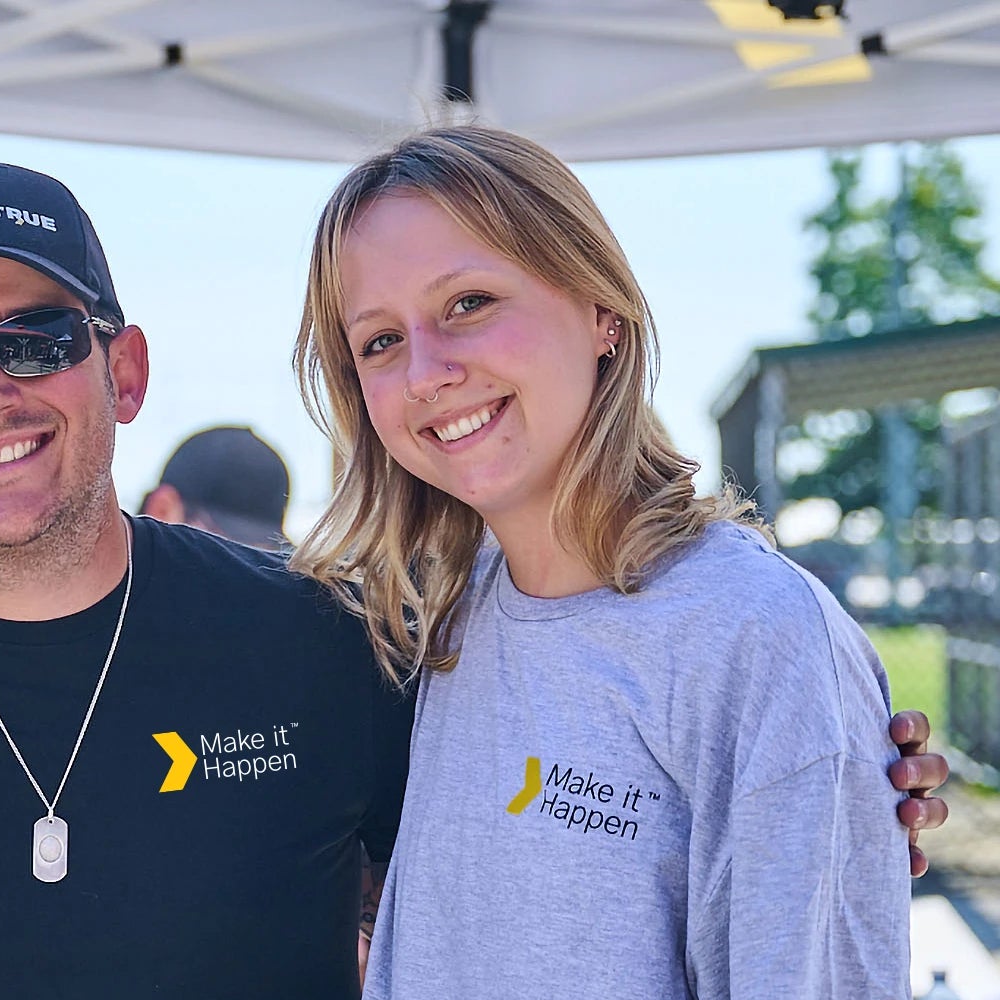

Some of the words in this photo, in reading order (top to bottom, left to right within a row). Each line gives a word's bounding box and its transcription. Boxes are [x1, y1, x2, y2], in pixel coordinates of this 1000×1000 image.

[200, 729, 265, 756] Make
[203, 752, 297, 782] Happen
[546, 763, 614, 803] Make
[539, 789, 639, 841] Happen
